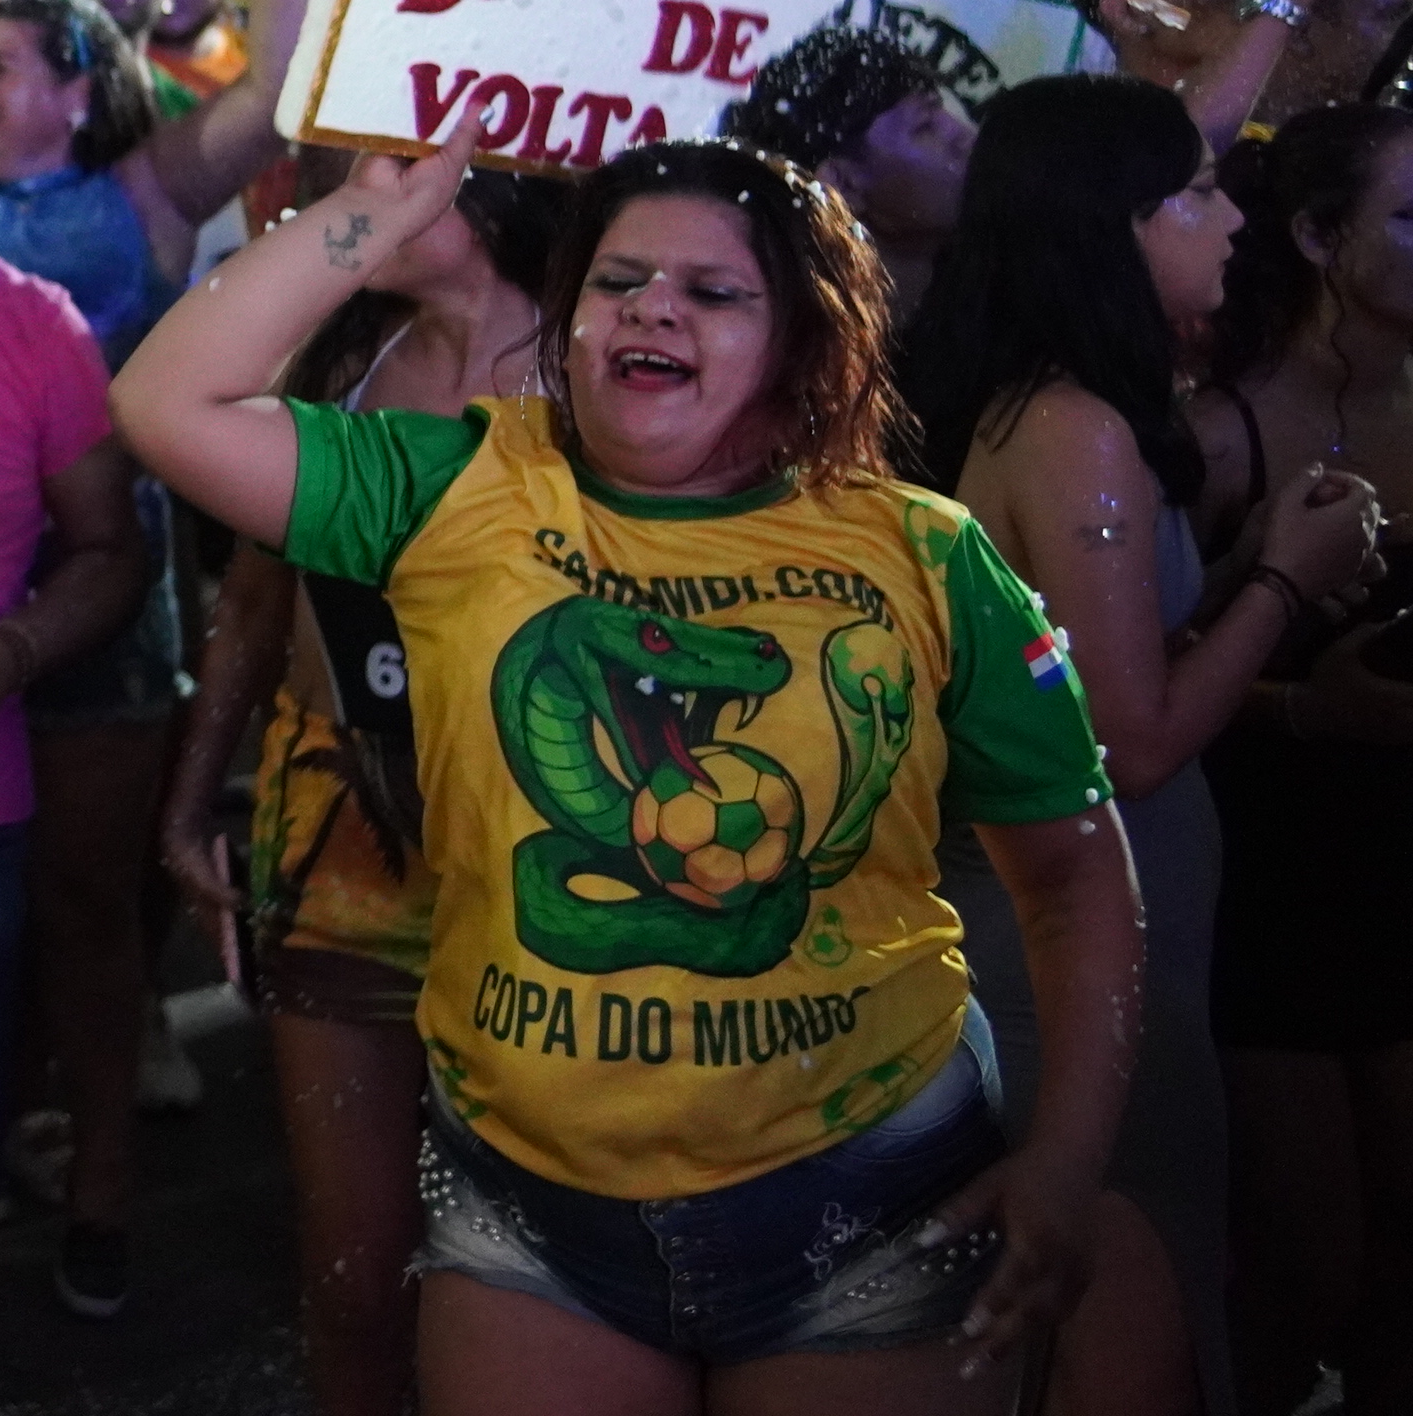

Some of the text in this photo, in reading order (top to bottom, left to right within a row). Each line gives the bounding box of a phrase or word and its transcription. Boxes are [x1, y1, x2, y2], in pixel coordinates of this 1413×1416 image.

[366, 640, 407, 699] 6
[474, 963, 872, 1068] COPA DO MUNDO
